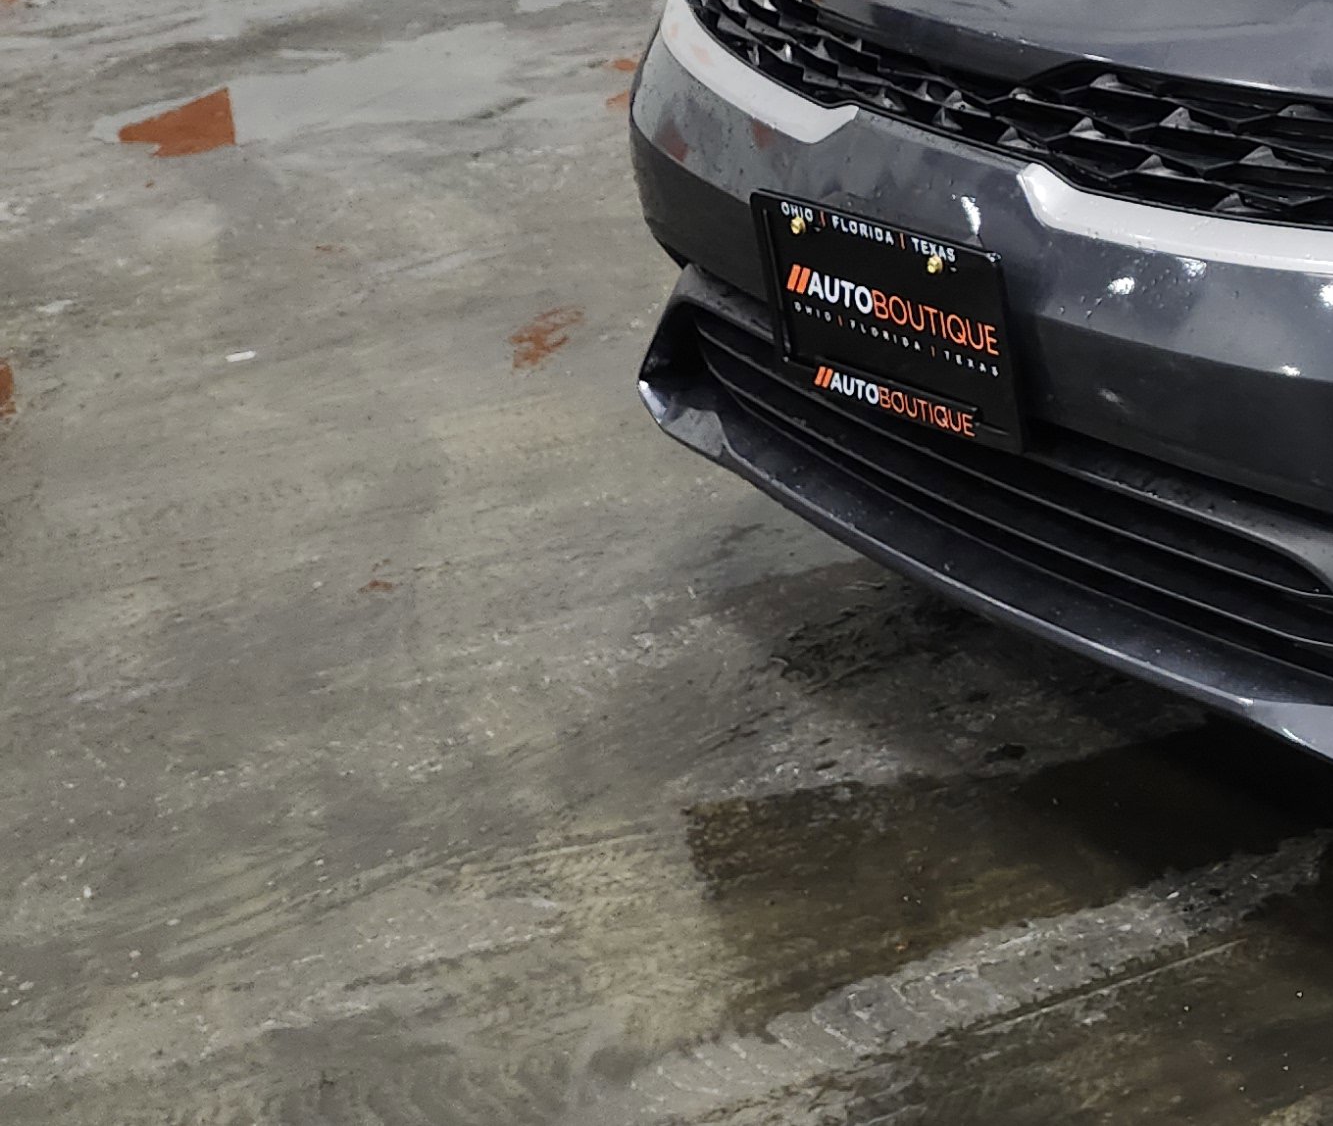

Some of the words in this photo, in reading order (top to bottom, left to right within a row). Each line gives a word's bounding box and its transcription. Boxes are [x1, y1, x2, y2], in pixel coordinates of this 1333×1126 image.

[781, 201, 813, 222] OHIO
[832, 216, 894, 245] FLORIDA
[911, 237, 955, 262] TEXAS
[794, 301, 832, 322] OHIO
[850, 319, 921, 351] FLORIDA
[944, 350, 999, 377] TEXAS
